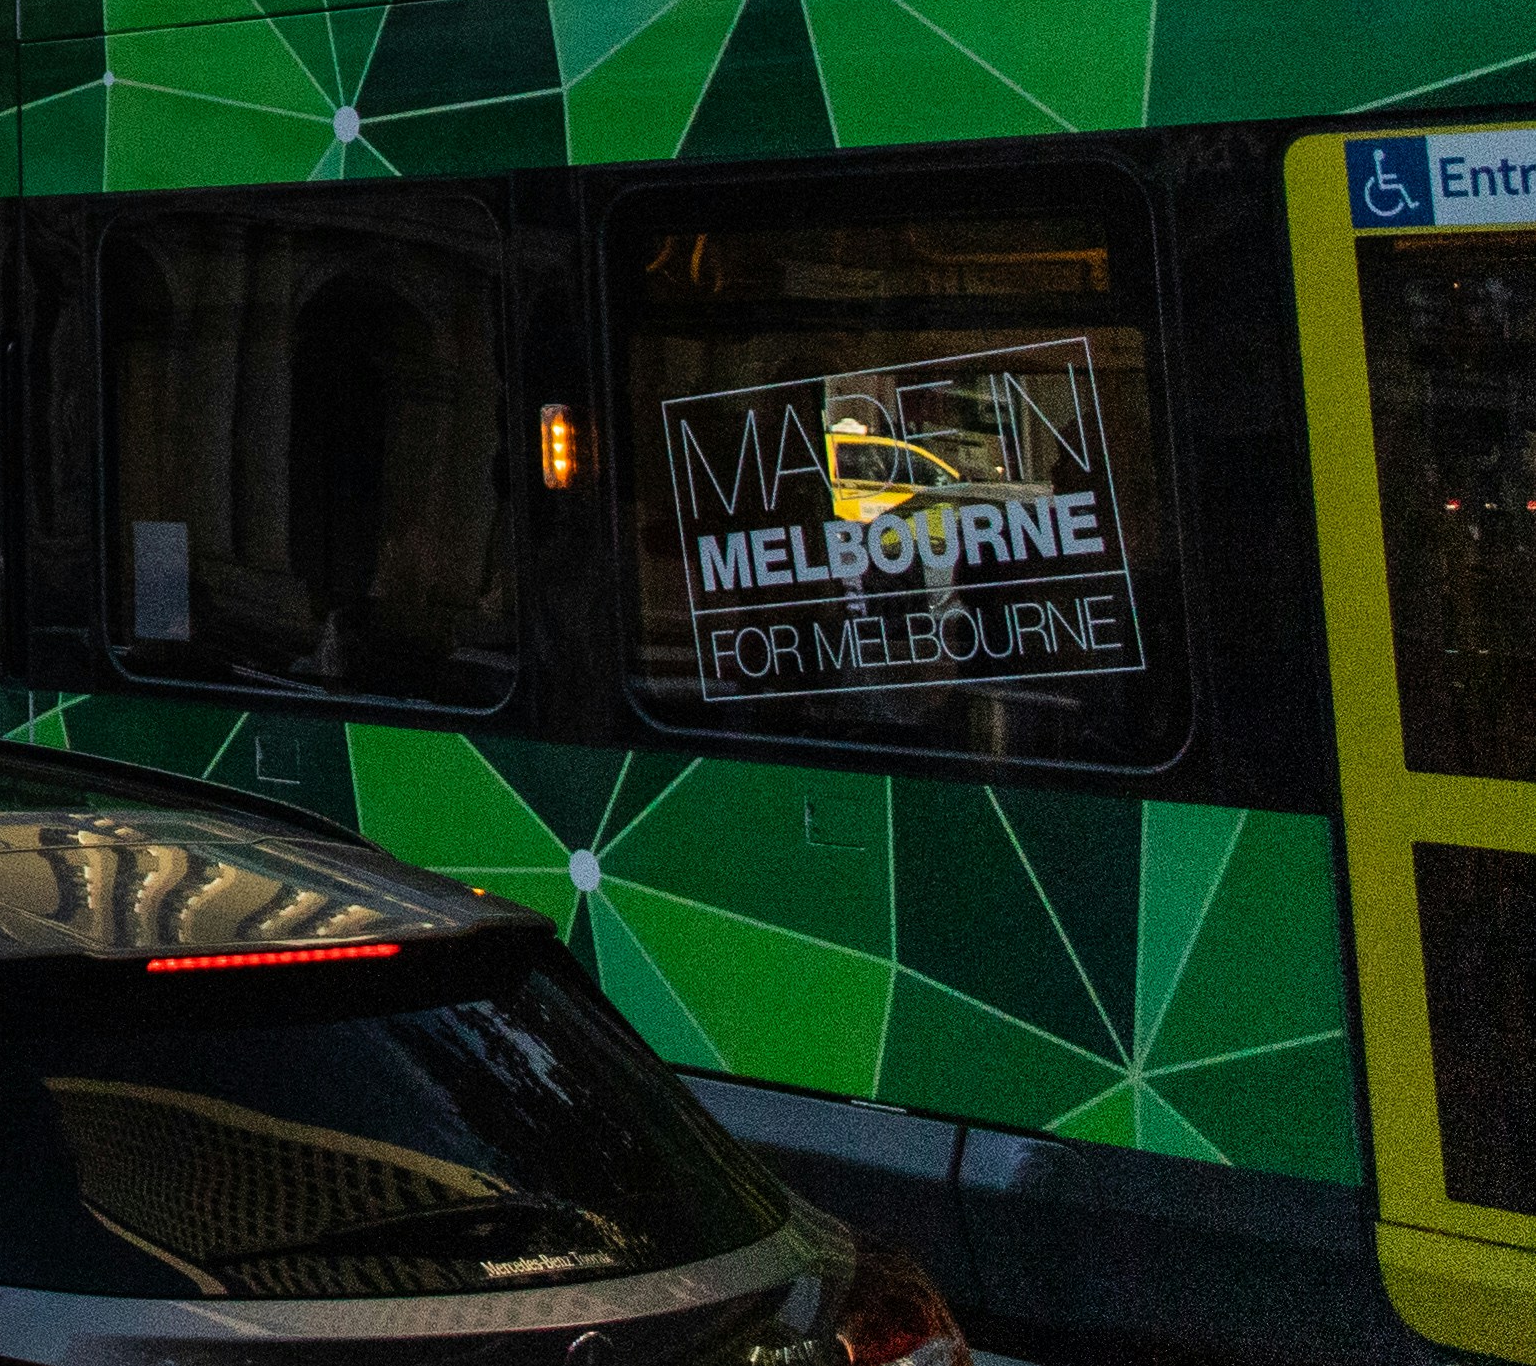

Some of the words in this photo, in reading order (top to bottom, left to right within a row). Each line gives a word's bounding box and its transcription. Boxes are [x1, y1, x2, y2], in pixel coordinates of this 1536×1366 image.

[681, 380, 959, 521] MADE
[991, 362, 1090, 482] IN
[698, 491, 1105, 592] MELBOURNE
[711, 624, 804, 680] FOR
[814, 596, 1123, 671] MELBOURNE
[480, 1254, 575, 1277] Mercedes-Benz
